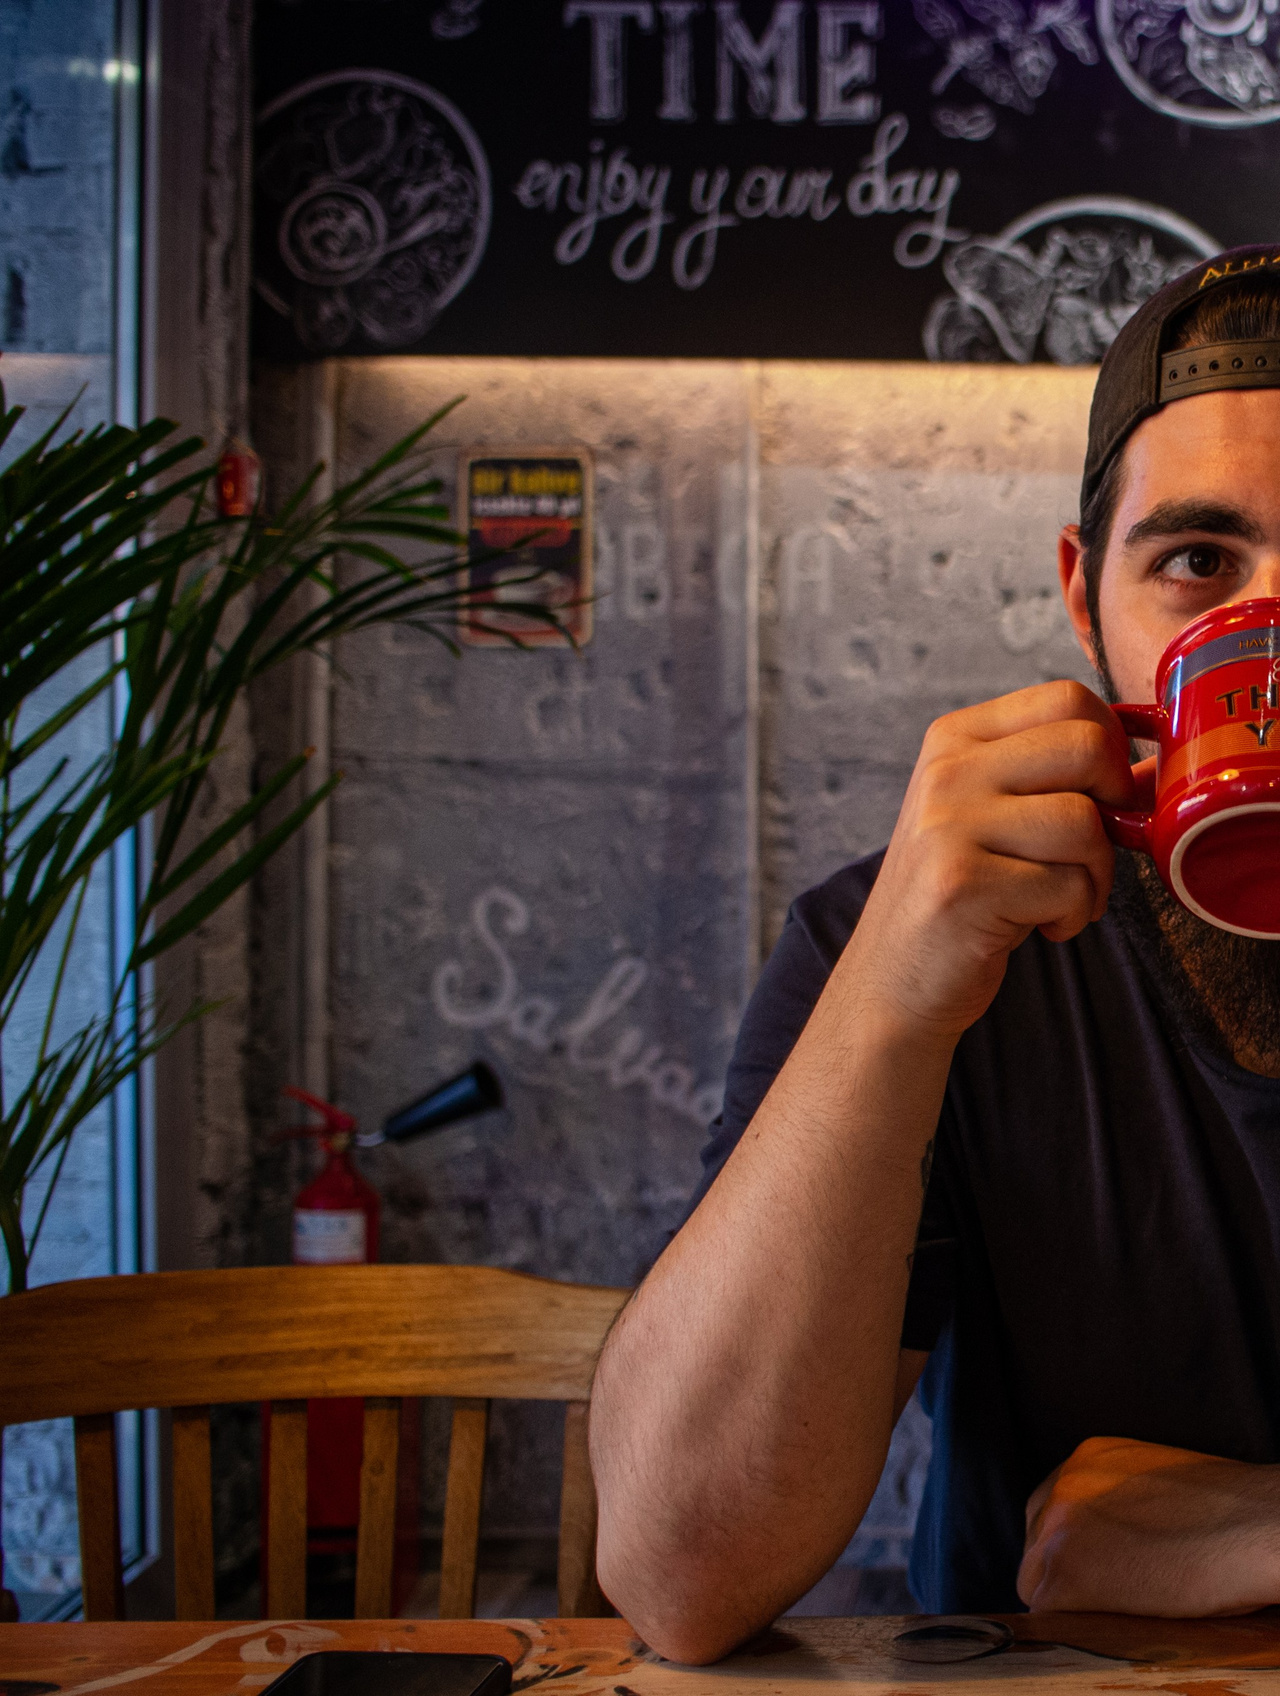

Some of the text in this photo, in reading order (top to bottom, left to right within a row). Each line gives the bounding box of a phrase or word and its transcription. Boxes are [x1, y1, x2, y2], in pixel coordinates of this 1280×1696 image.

[563, 0, 884, 124] TIME
[514, 140, 673, 281] enjoy
[846, 113, 969, 267] day
